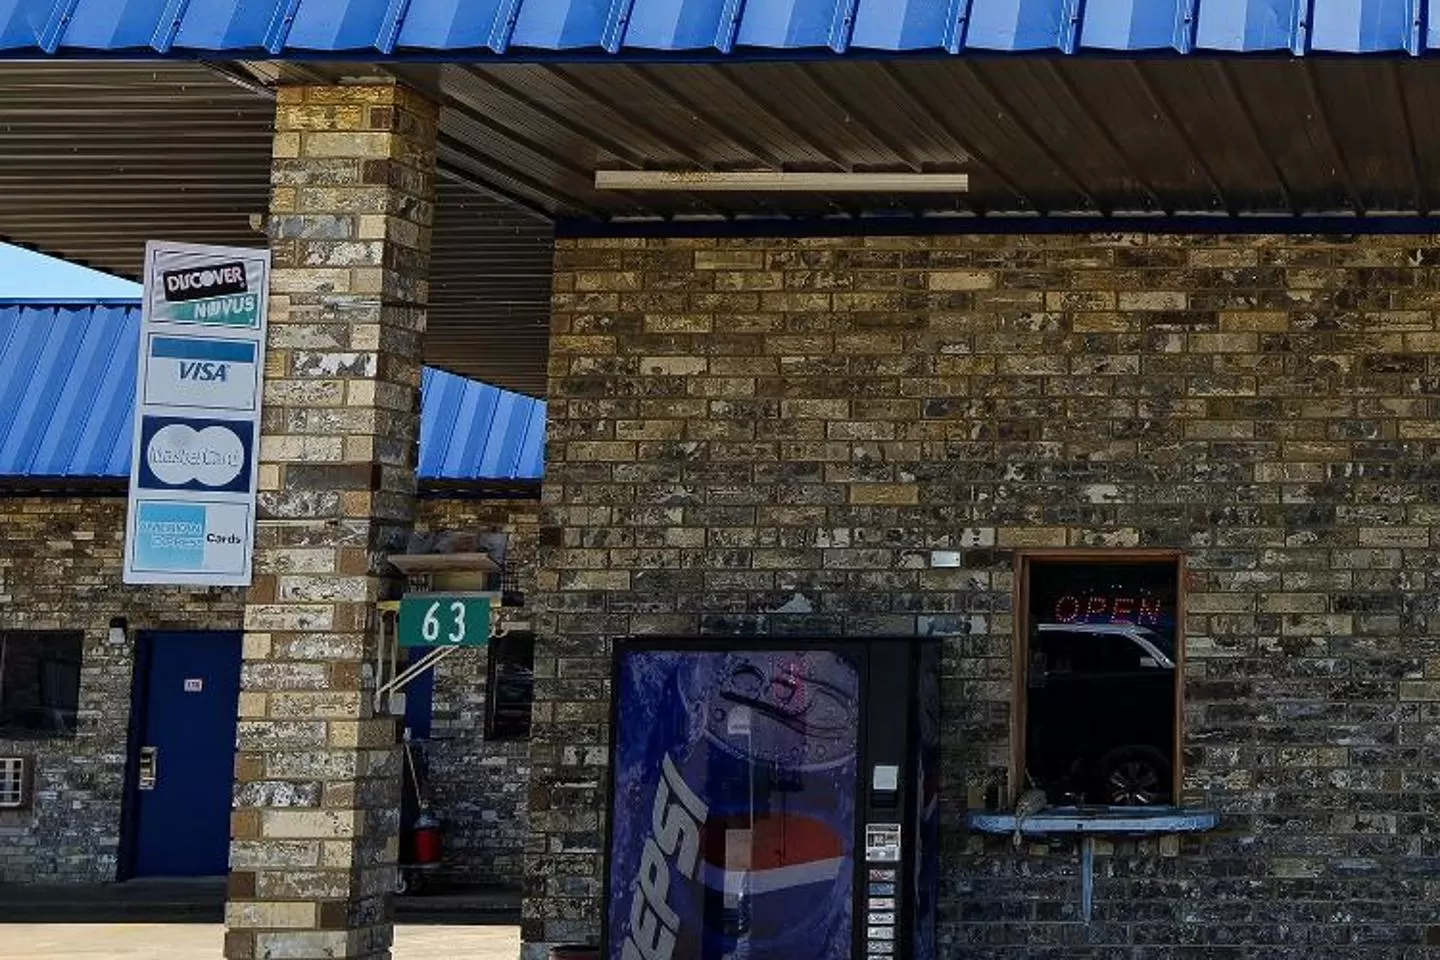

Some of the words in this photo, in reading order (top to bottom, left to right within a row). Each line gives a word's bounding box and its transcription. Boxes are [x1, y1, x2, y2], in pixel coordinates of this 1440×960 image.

[167, 266, 242, 292] DISCOVER
[194, 296, 255, 319] NOVUS
[179, 361, 227, 382] VISA
[206, 533, 241, 545] Cards
[422, 601, 466, 642] 63
[1055, 596, 1161, 624] OPEN
[621, 751, 709, 960] EPSI
